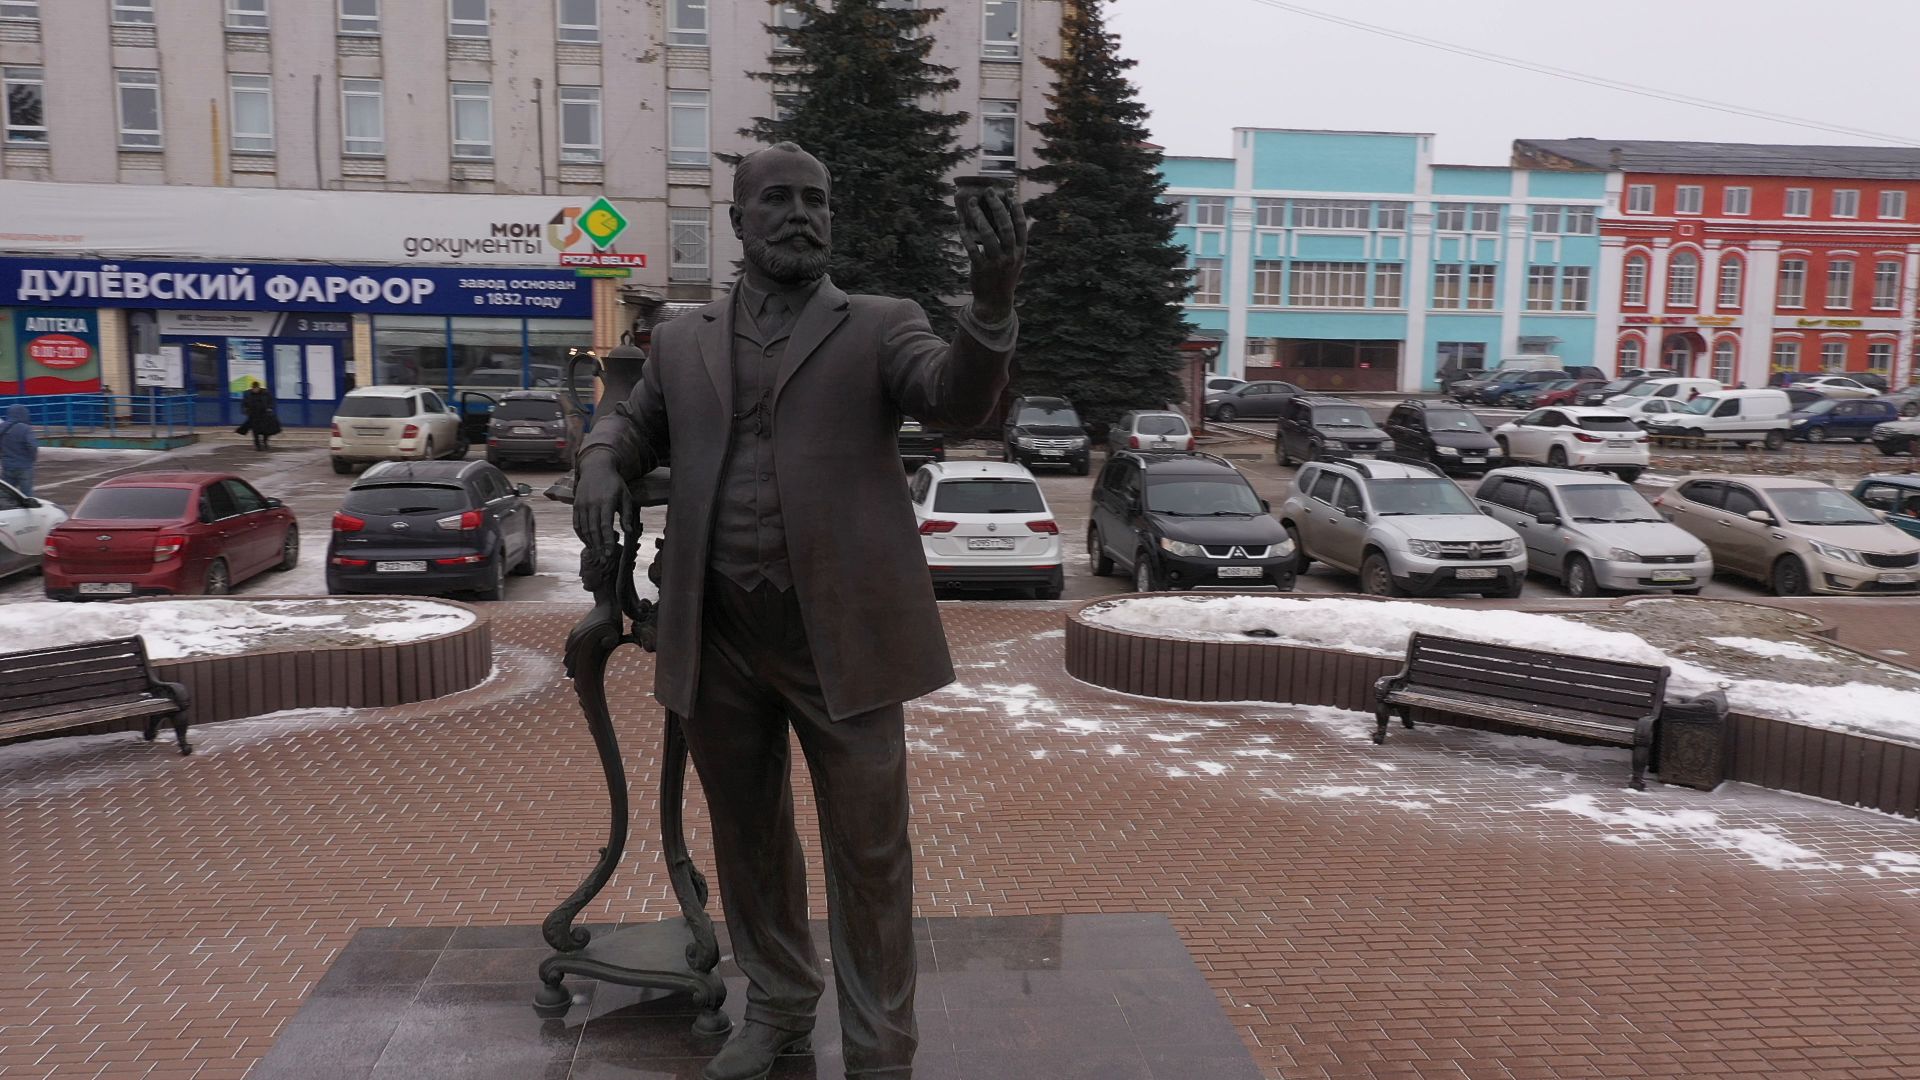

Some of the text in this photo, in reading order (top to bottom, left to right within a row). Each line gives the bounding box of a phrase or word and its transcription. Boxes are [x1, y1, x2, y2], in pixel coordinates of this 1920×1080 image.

[403, 237, 542, 258] документы
[562, 254, 643, 266] PIZZA BELLA
[17, 264, 436, 305] ДУЛЁВСКИЙ ФАРФОР
[458, 278, 577, 291] завод основан
[473, 292, 563, 309] в 1832 году
[25, 316, 89, 333] АПТЕКА
[298, 318, 348, 333] 3 этаж
